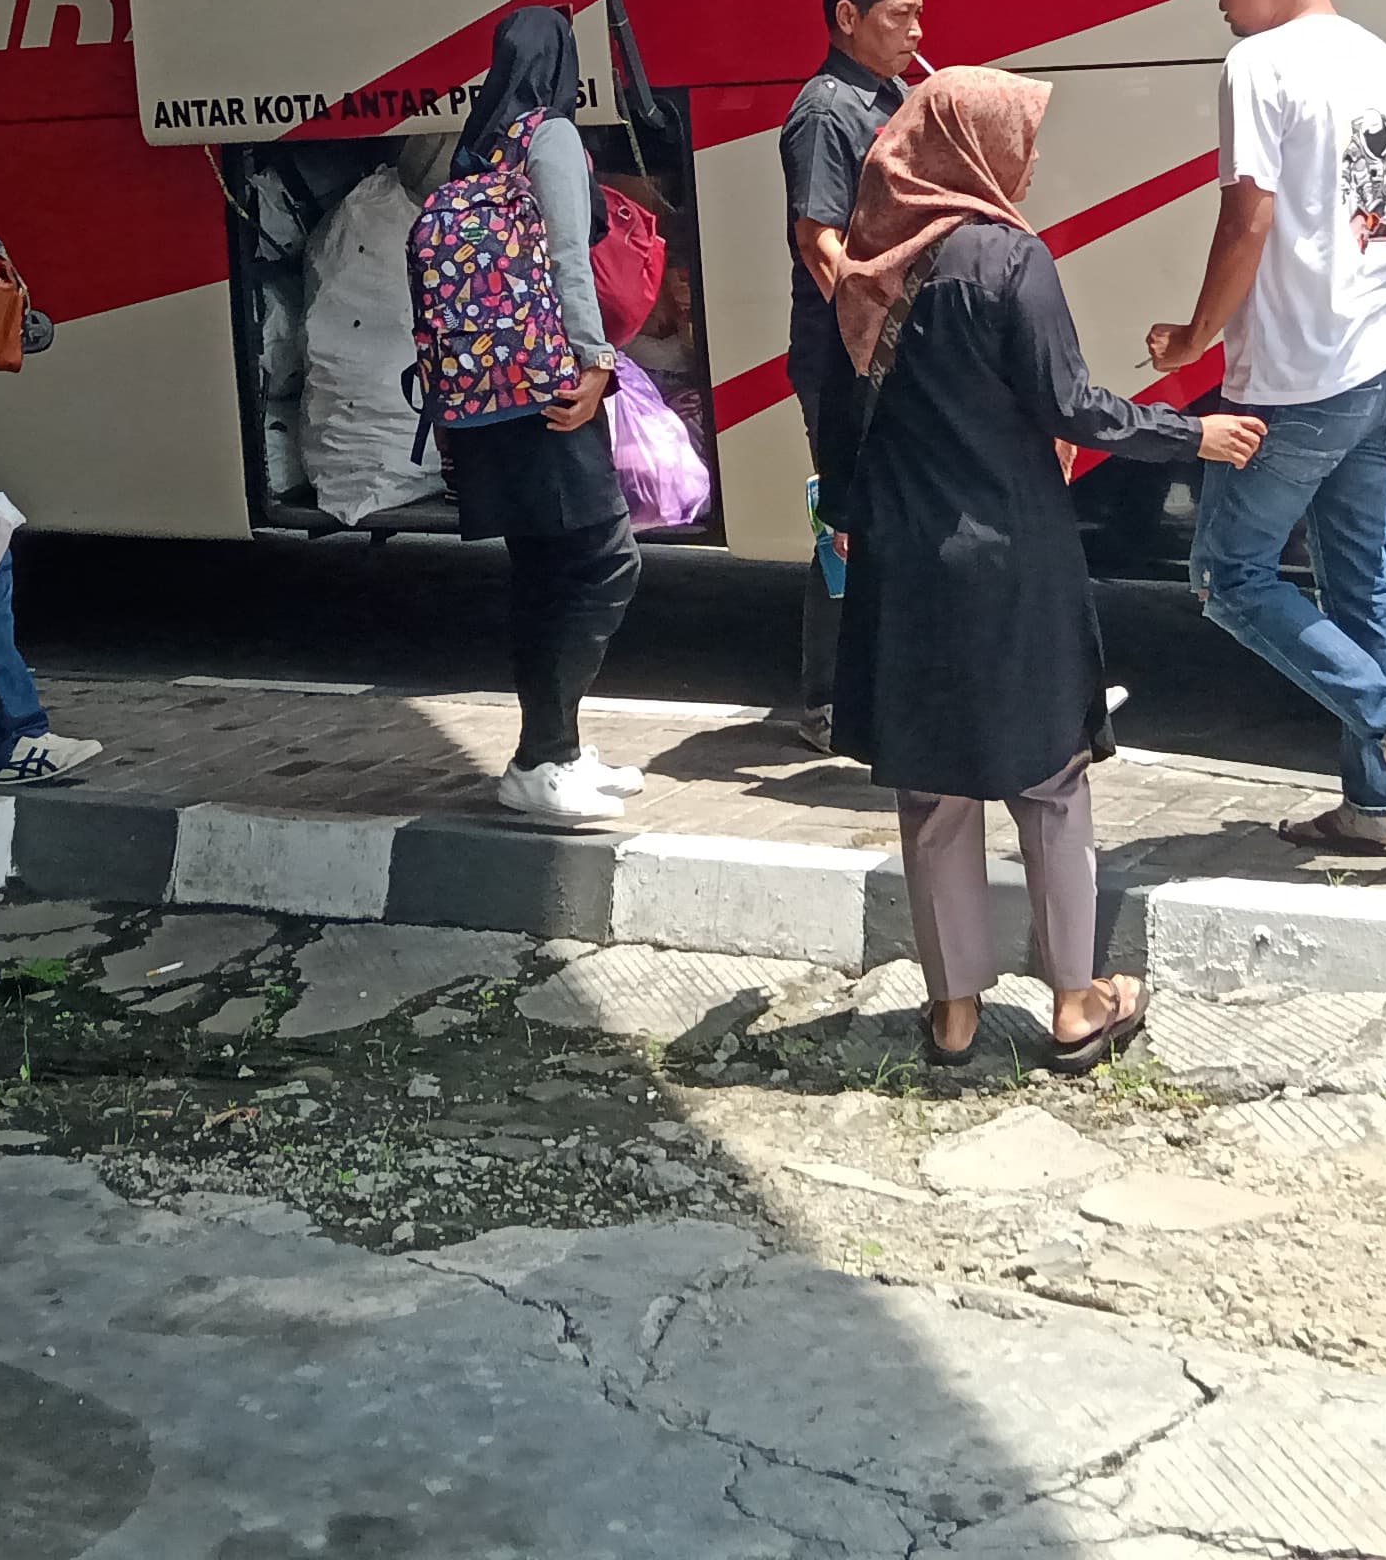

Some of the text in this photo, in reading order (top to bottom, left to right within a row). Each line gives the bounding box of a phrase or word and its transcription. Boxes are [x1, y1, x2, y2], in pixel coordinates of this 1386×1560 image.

[154, 98, 248, 129] ANTAR
[255, 93, 330, 124] KOTA
[340, 88, 442, 121] ANTAR
